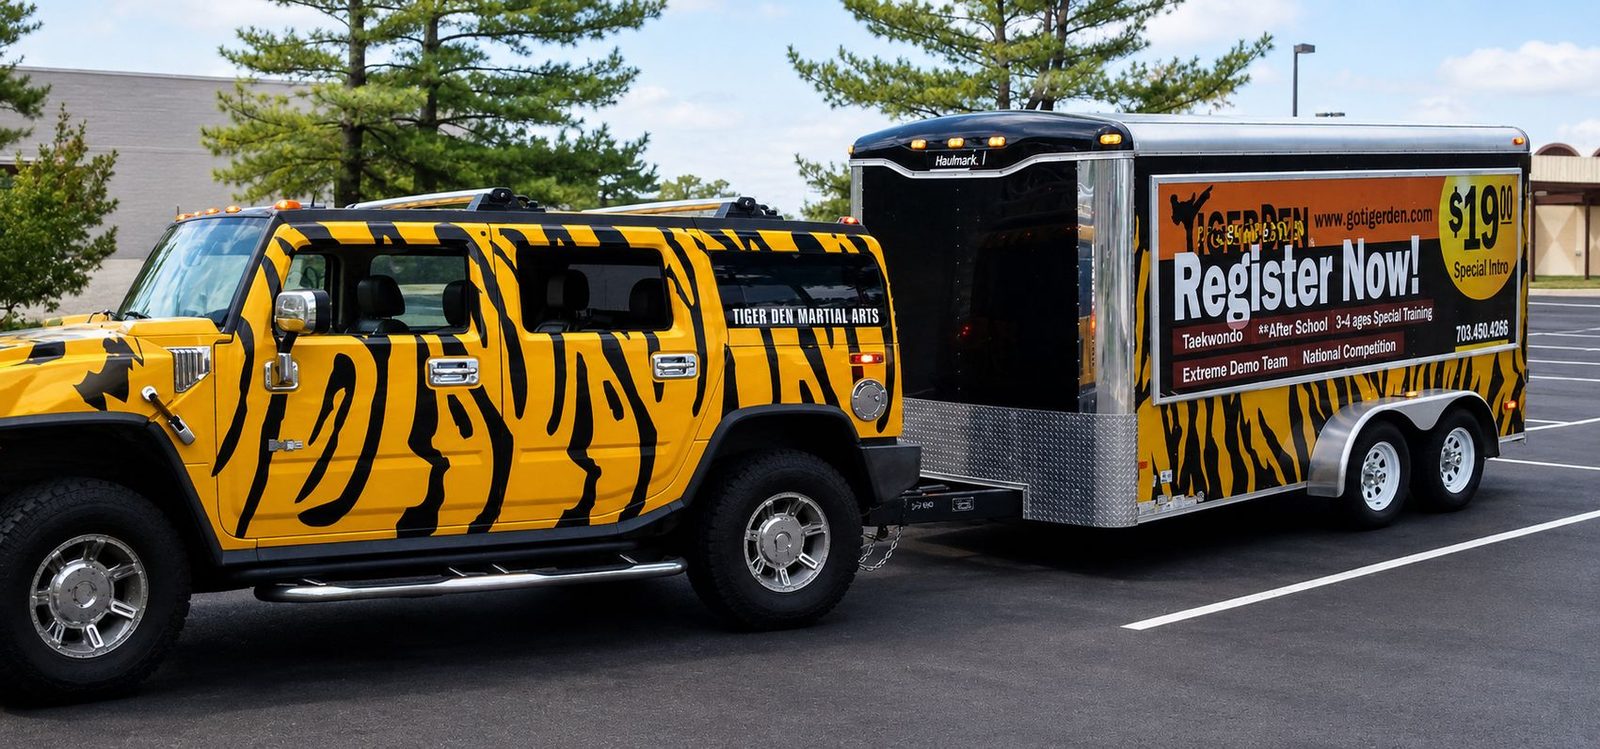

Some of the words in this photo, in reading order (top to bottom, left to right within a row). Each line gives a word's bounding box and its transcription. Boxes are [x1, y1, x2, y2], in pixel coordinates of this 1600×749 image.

[1314, 206, 1433, 230] www.gotigerden.com
[1454, 258, 1487, 282] Special
[1489, 260, 1509, 276] Intro
[1174, 244, 1333, 330] Register
[1342, 235, 1420, 302] Now!
[732, 308, 767, 324] TIGER
[770, 308, 794, 324] DEN
[797, 308, 848, 324] MARTIAL
[851, 308, 880, 324] ARTS
[1295, 317, 1328, 334] School
[1335, 313, 1351, 329] 3-4
[1352, 314, 1372, 330] ages
[1373, 308, 1402, 326] Special
[1403, 306, 1433, 321] Training
[1182, 329, 1243, 349] Taekwondo
[1456, 319, 1509, 343] 703.450.4266
[1302, 345, 1341, 364] National
[1343, 339, 1396, 359] Competition
[1183, 365, 1227, 383] Extreme
[1229, 360, 1260, 376] Demo
[1261, 355, 1289, 370] Team
